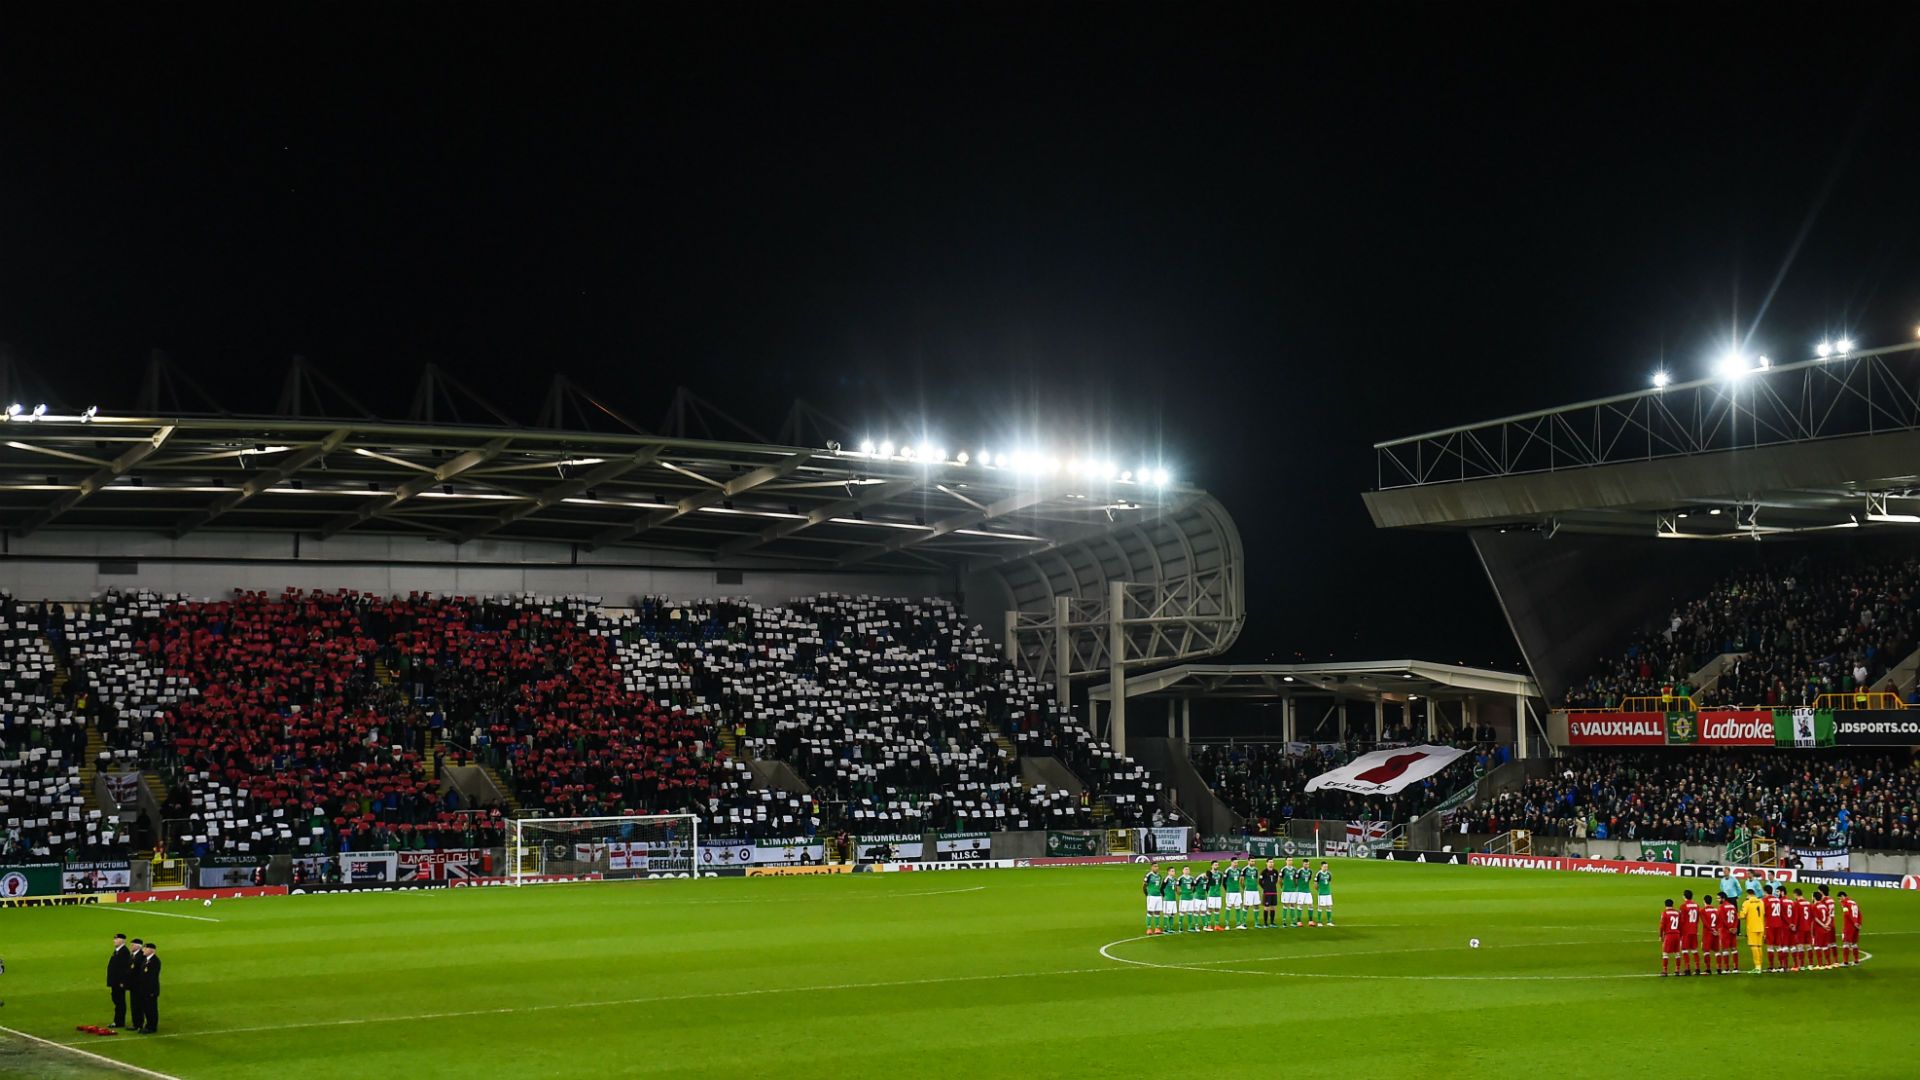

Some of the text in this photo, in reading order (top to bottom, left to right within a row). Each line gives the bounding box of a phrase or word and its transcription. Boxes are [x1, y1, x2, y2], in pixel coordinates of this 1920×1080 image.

[1581, 722, 1663, 736] VAUXHALL
[861, 834, 921, 843] DRUMREAGH
[66, 861, 128, 871] LURGAN VICTORIA
[1688, 908, 1698, 923] 10
[1711, 913, 1717, 927] 2
[1803, 906, 1809, 920] 5
